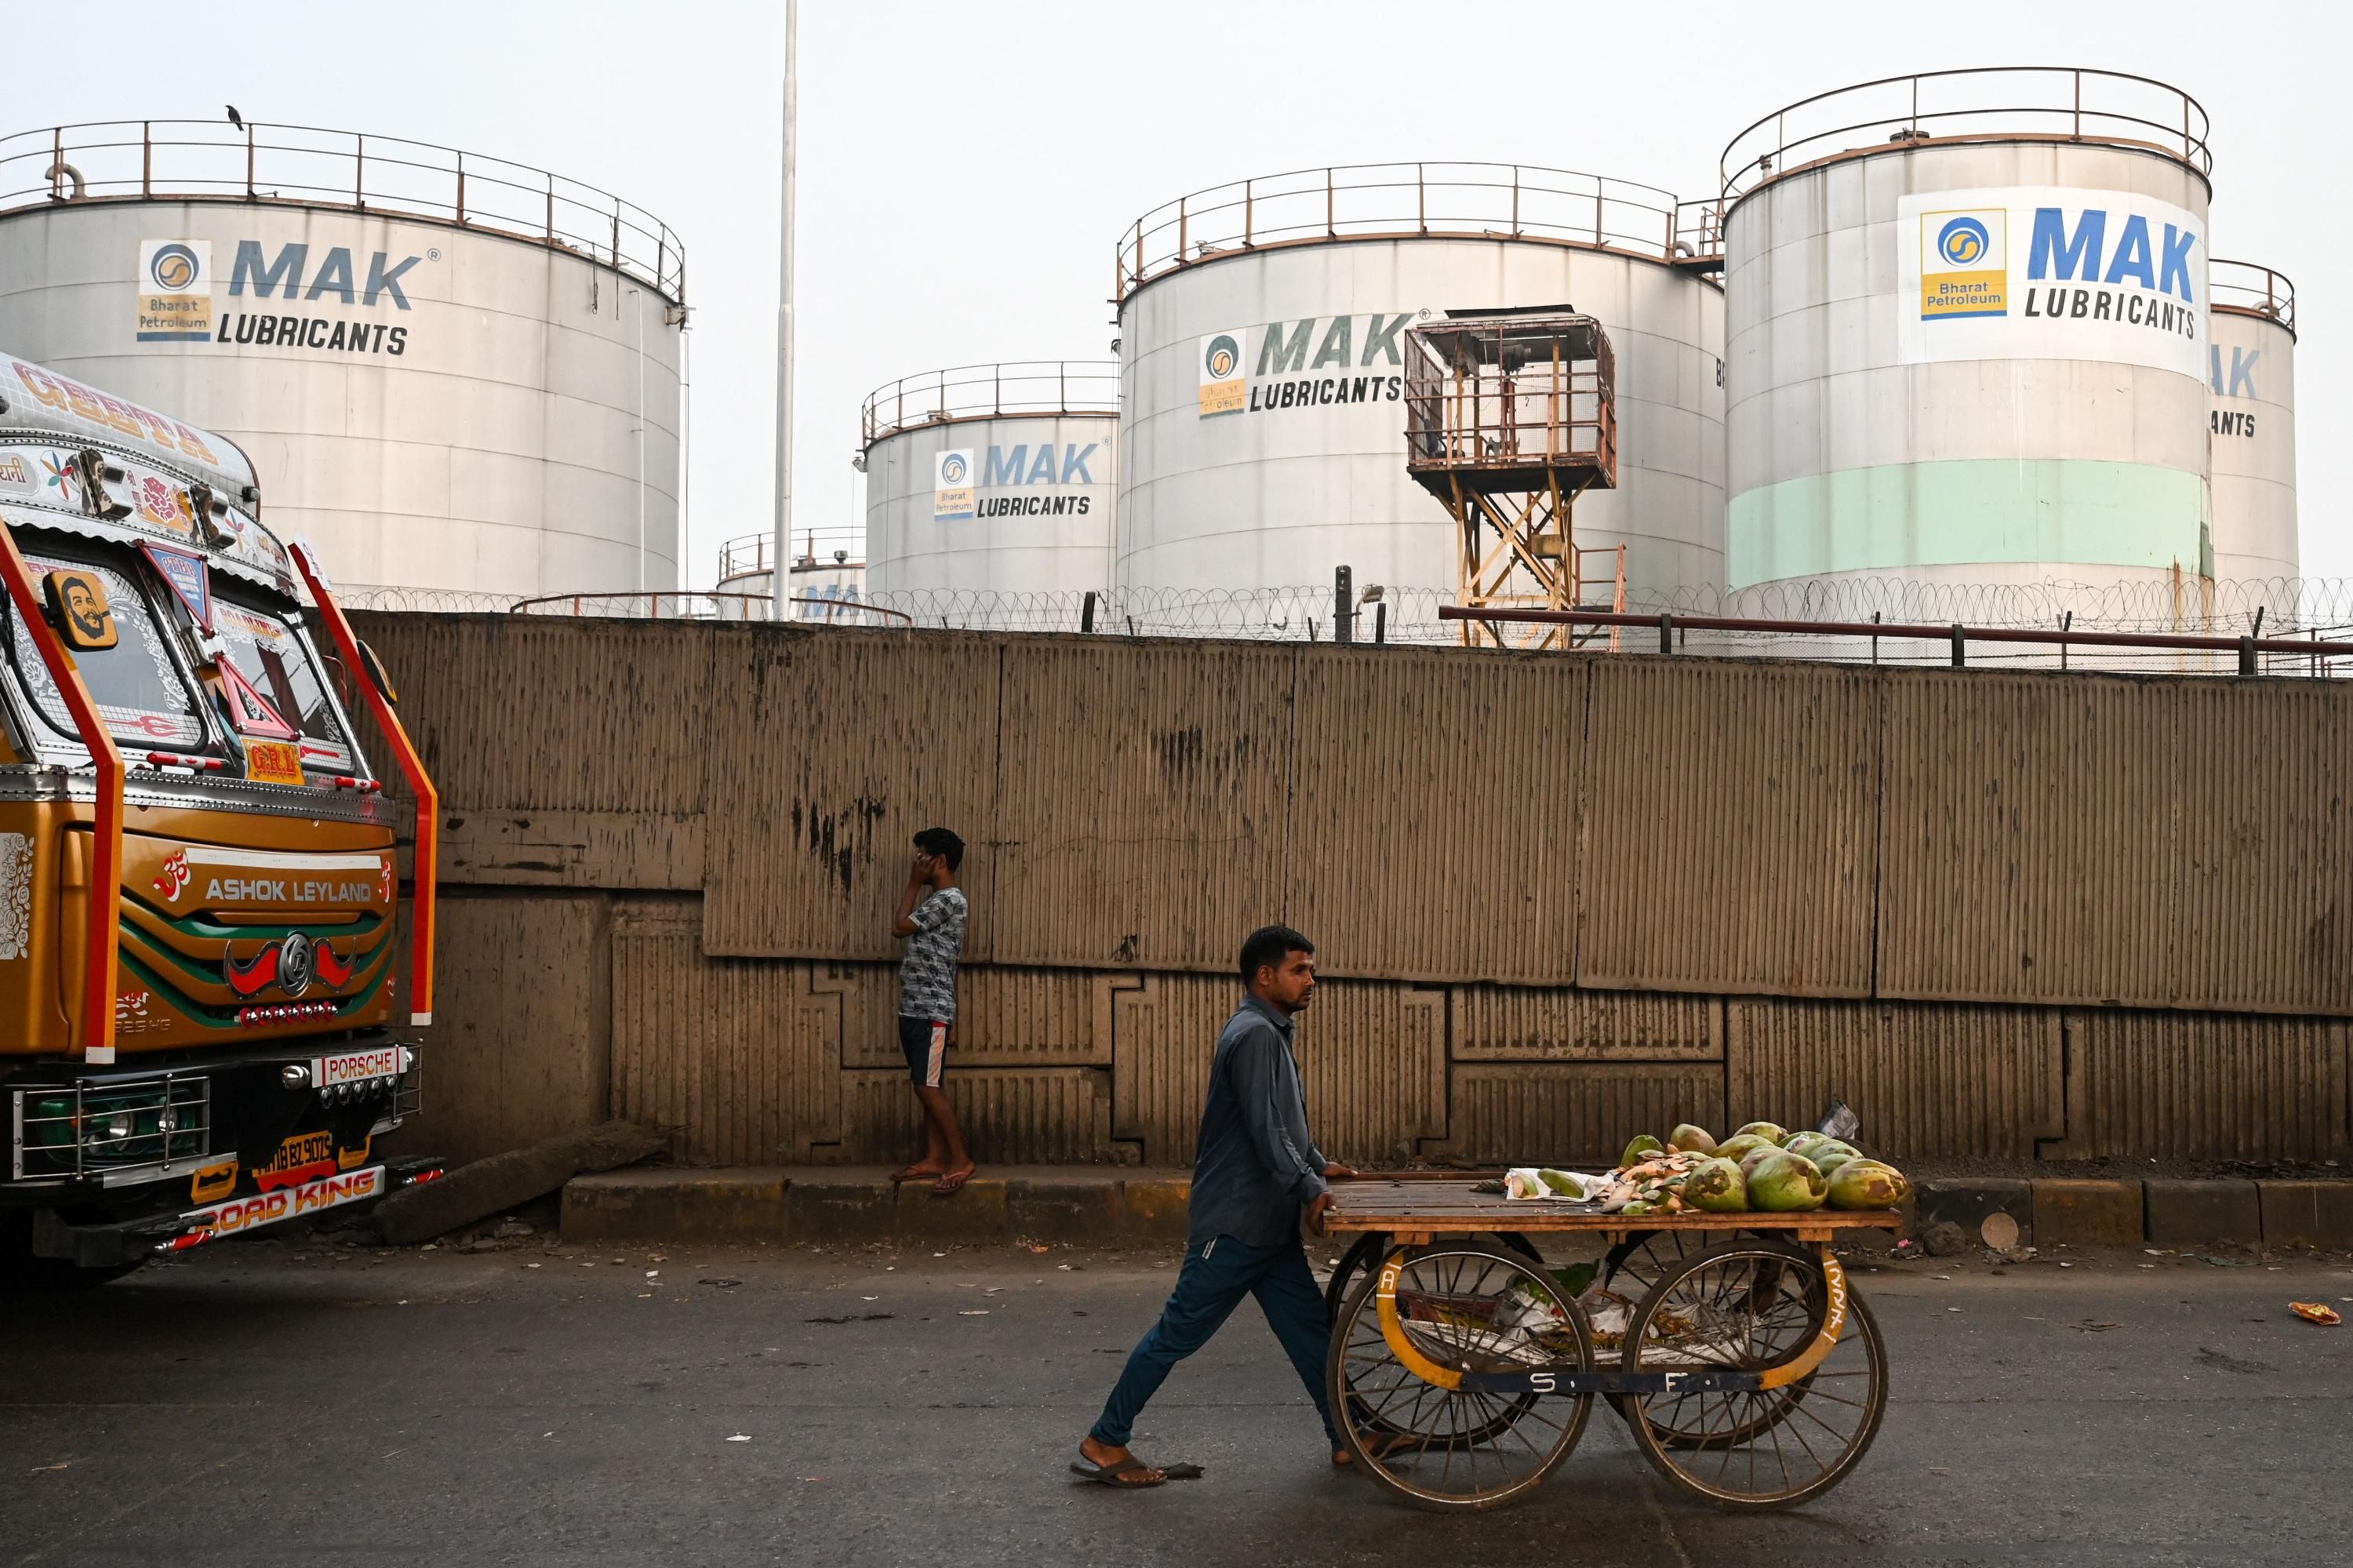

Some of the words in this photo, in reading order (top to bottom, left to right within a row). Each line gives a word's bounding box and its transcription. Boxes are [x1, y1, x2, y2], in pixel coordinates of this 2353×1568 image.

[2028, 208, 2195, 303] MAK
[228, 240, 422, 311] MAK
[1940, 282, 1988, 294] Bharat
[151, 299, 198, 311] Bharat
[1927, 293, 2001, 307] Petroleum
[2025, 288, 2194, 340] LUBRICANTS
[140, 316, 206, 329] Petroleum
[217, 314, 407, 355] LUBRICANTS
[1255, 313, 1416, 377] MAK
[1249, 377, 1402, 412] LUBRICANTS
[12, 362, 219, 466] GEETA
[982, 443, 1098, 485] MAK
[936, 502, 973, 511] Petroleum
[941, 493, 966, 501] Bharat
[977, 496, 1090, 518] LUBRICANTS
[205, 879, 286, 901] ASHOK
[293, 882, 371, 902] LEYLAND
[330, 1052, 392, 1080] PORSCHE
[295, 1170, 376, 1215] KING
[1380, 1270, 1395, 1290] A
[1829, 1268, 1845, 1329] 227
